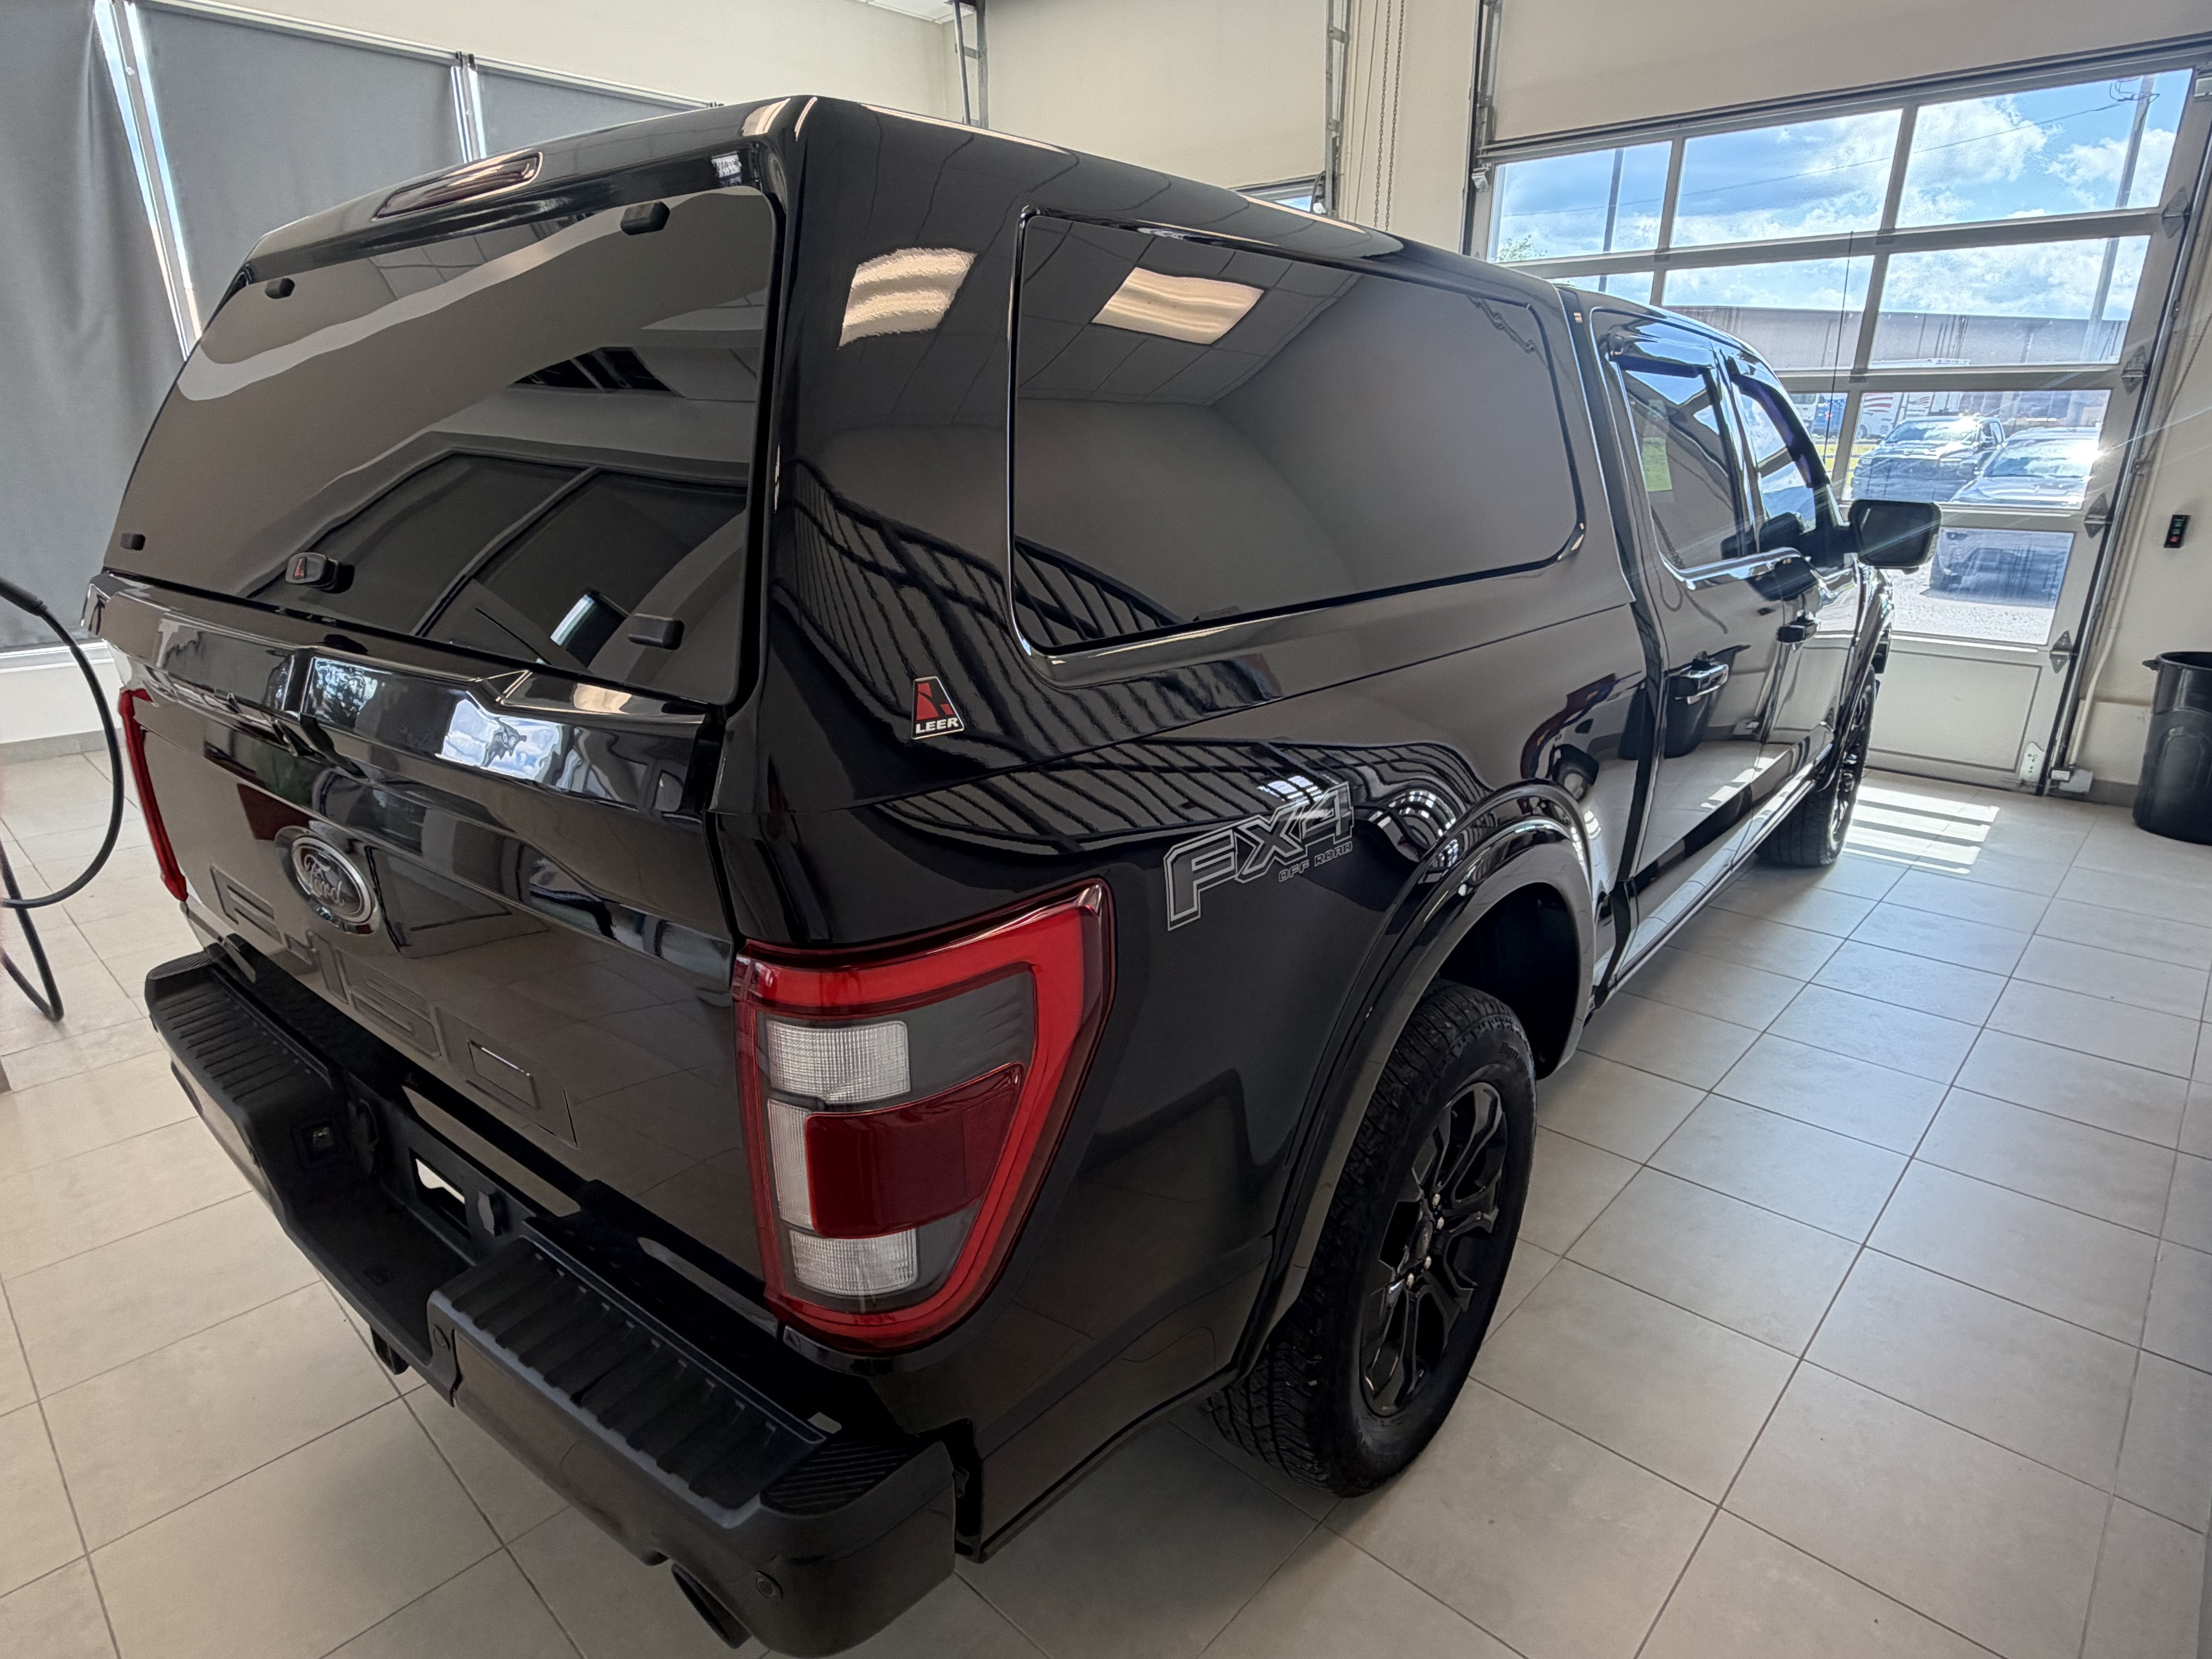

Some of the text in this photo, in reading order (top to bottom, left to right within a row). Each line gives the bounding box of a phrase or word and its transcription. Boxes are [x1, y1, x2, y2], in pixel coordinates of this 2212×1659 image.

[916, 718, 958, 734] LEER
[304, 853, 345, 907] Ford
[1163, 781, 1355, 932] FX4
[1278, 841, 1353, 883] OFF ROAD
